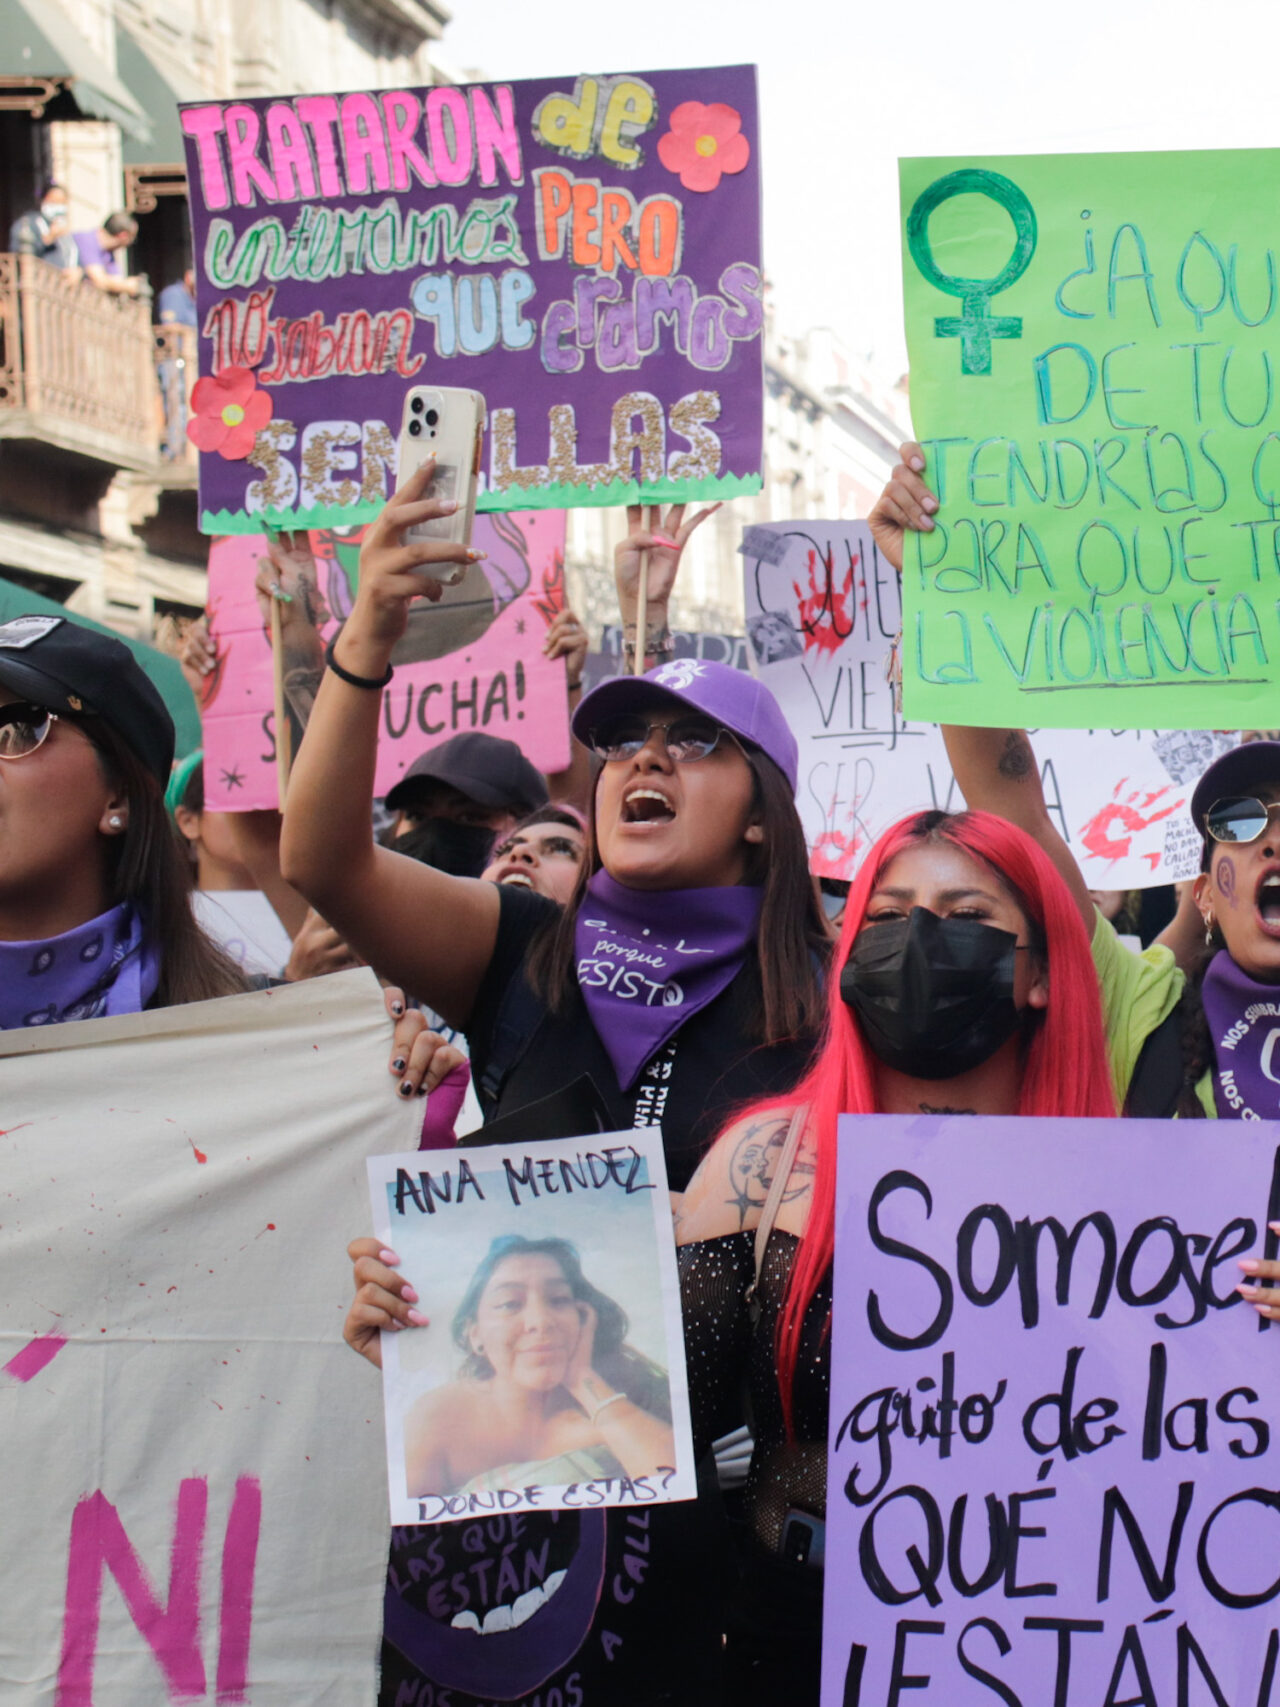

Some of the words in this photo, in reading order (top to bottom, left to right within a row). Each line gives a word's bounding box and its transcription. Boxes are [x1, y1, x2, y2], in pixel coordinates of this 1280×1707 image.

[181, 86, 522, 209] TRATARON
[537, 78, 657, 167] de
[537, 170, 680, 276] PERO
[412, 271, 534, 355] que
[1056, 210, 1162, 328] ¿A
[1034, 342, 1149, 429] DE
[1171, 341, 1273, 428] TU
[755, 531, 903, 640] QUIE
[1076, 518, 1221, 613] QUE
[383, 660, 526, 739] UCHA!
[592, 940, 666, 968] porque
[1221, 1020, 1249, 1050] NOS
[1220, 1070, 1244, 1110] NOS
[393, 1159, 485, 1216] ANA
[501, 1145, 657, 1206] MENDEZ
[1023, 1346, 1127, 1462] de
[1142, 1342, 1271, 1462] las
[416, 1483, 546, 1521] DONDE
[858, 1458, 1059, 1607] QUÉ
[54, 1467, 263, 1707] NI
